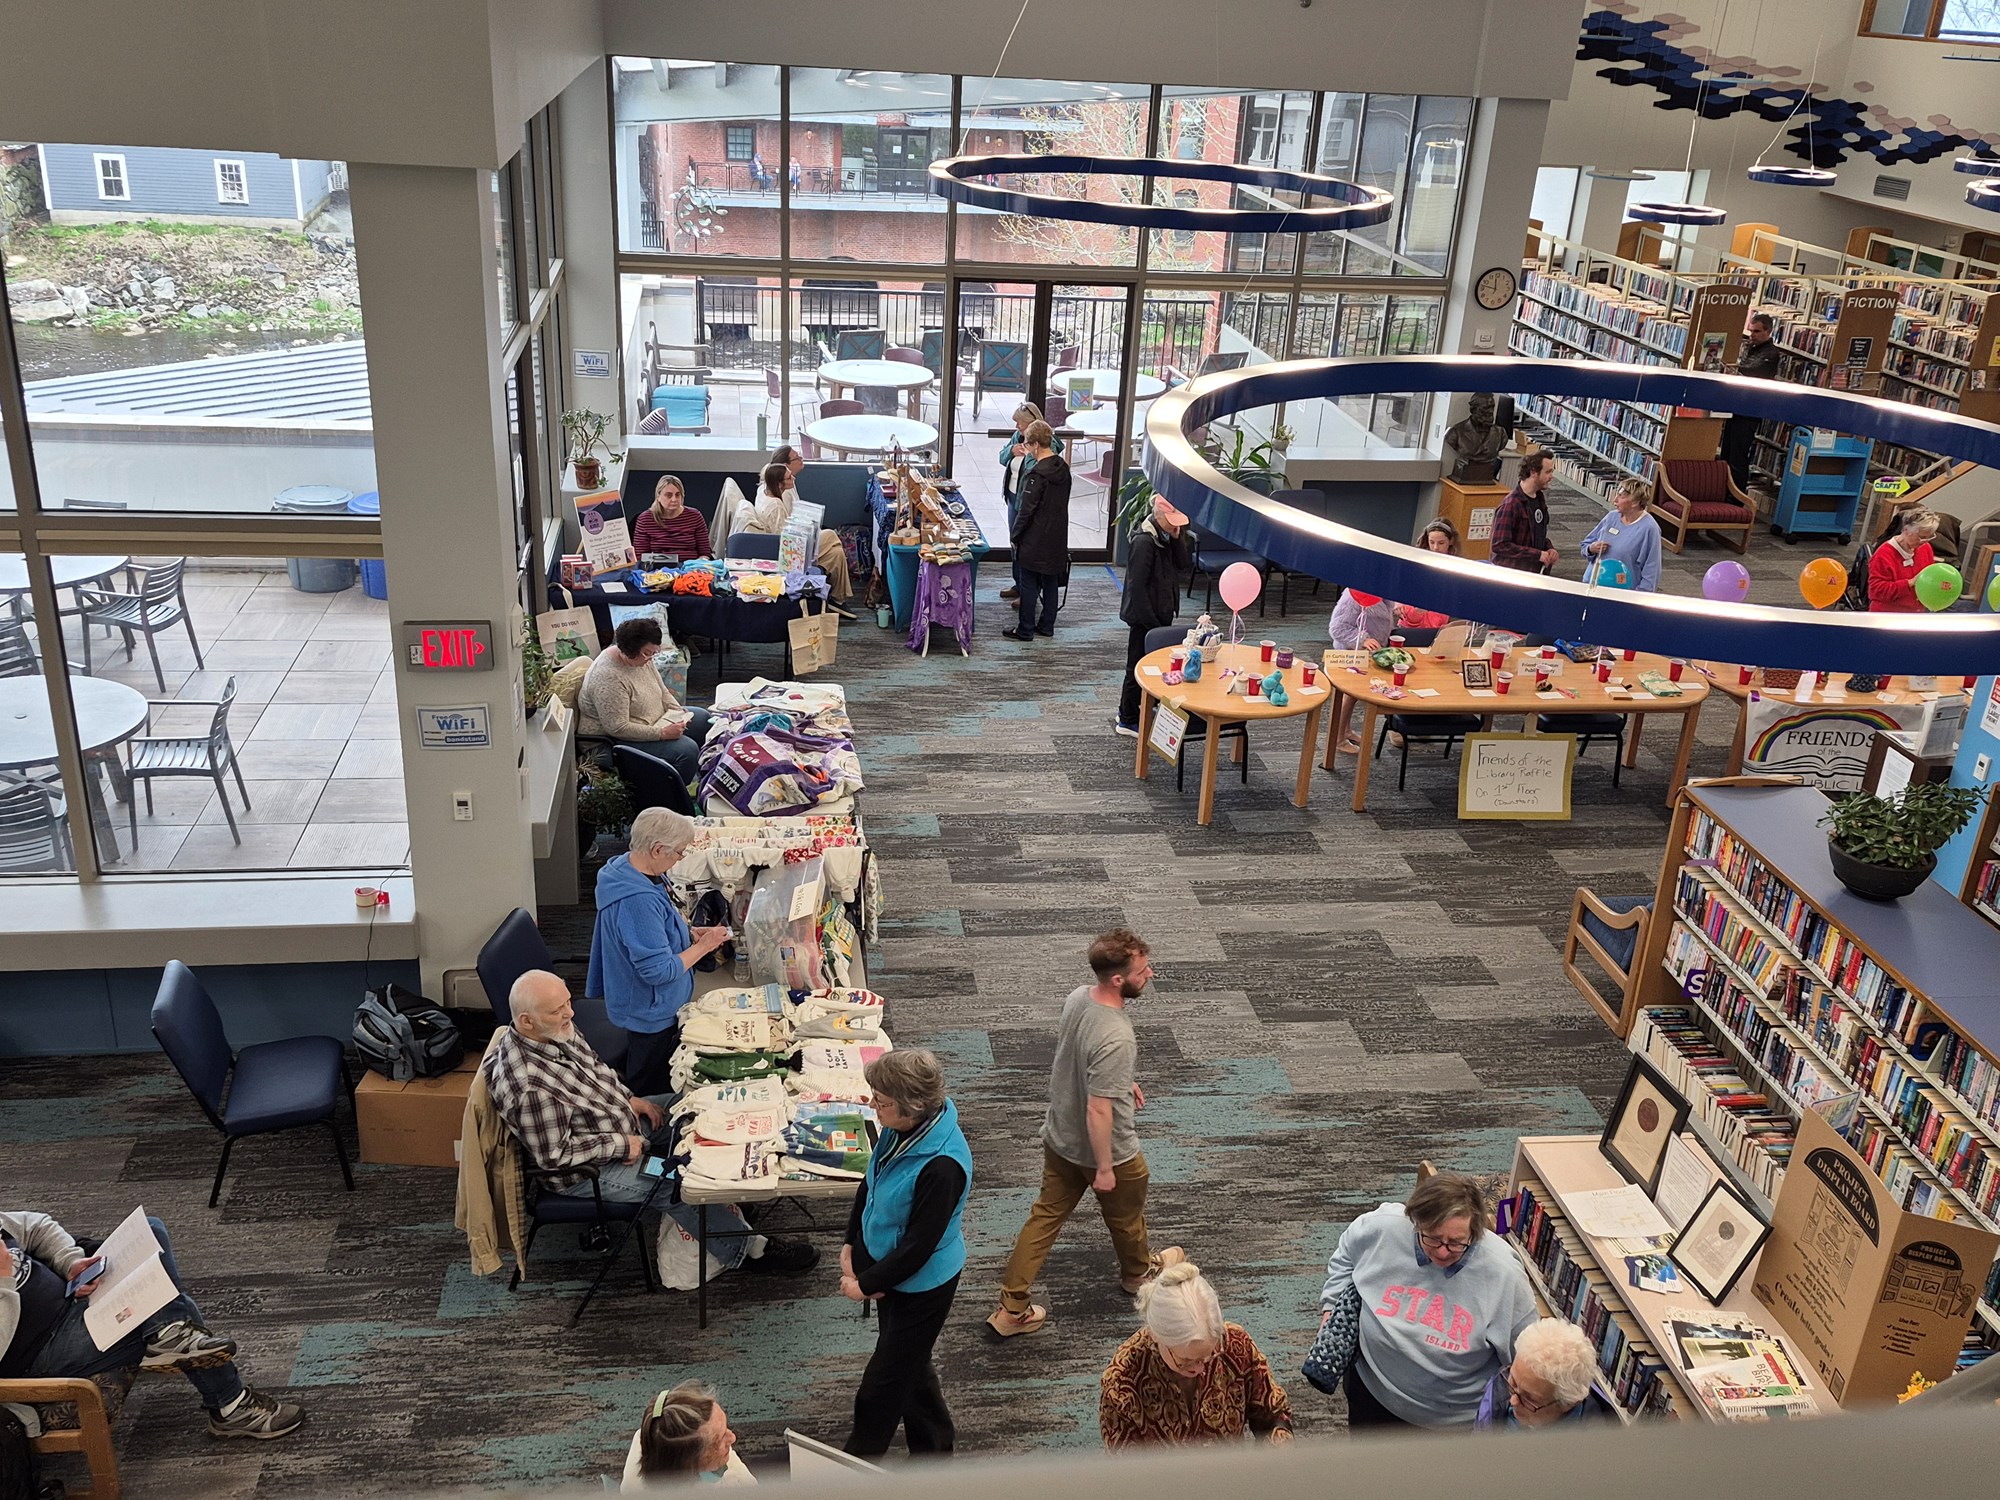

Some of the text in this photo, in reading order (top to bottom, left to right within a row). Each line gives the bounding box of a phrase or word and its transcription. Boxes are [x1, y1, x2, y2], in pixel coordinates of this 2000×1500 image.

[1699, 294, 1748, 305] FICTION
[1847, 297, 1896, 309] FICTION
[1827, 308, 1835, 319] F
[422, 630, 476, 667] EXIT
[437, 718, 475, 730] WiFi
[1786, 731, 1875, 748] FRIENDS
[1478, 744, 1552, 766] Friends of the
[1817, 747, 1842, 756] of the
[1476, 767, 1552, 785] Library Raffle
[1476, 787, 1489, 797] On
[1687, 974, 1703, 993] S
[1833, 1159, 1869, 1202] PROJECT
[1817, 1157, 1849, 1198] DISPLAY
[1850, 1196, 1876, 1230] BOARD
[1908, 1249, 1955, 1266] DISPLAY BOARD
[1921, 1244, 1948, 1256] PROJECT
[1775, 1282, 1800, 1316] Create
[1800, 1312, 1815, 1335] better
[1375, 1285, 1475, 1351] STAR
[1425, 1334, 1460, 1352] ISLAND
